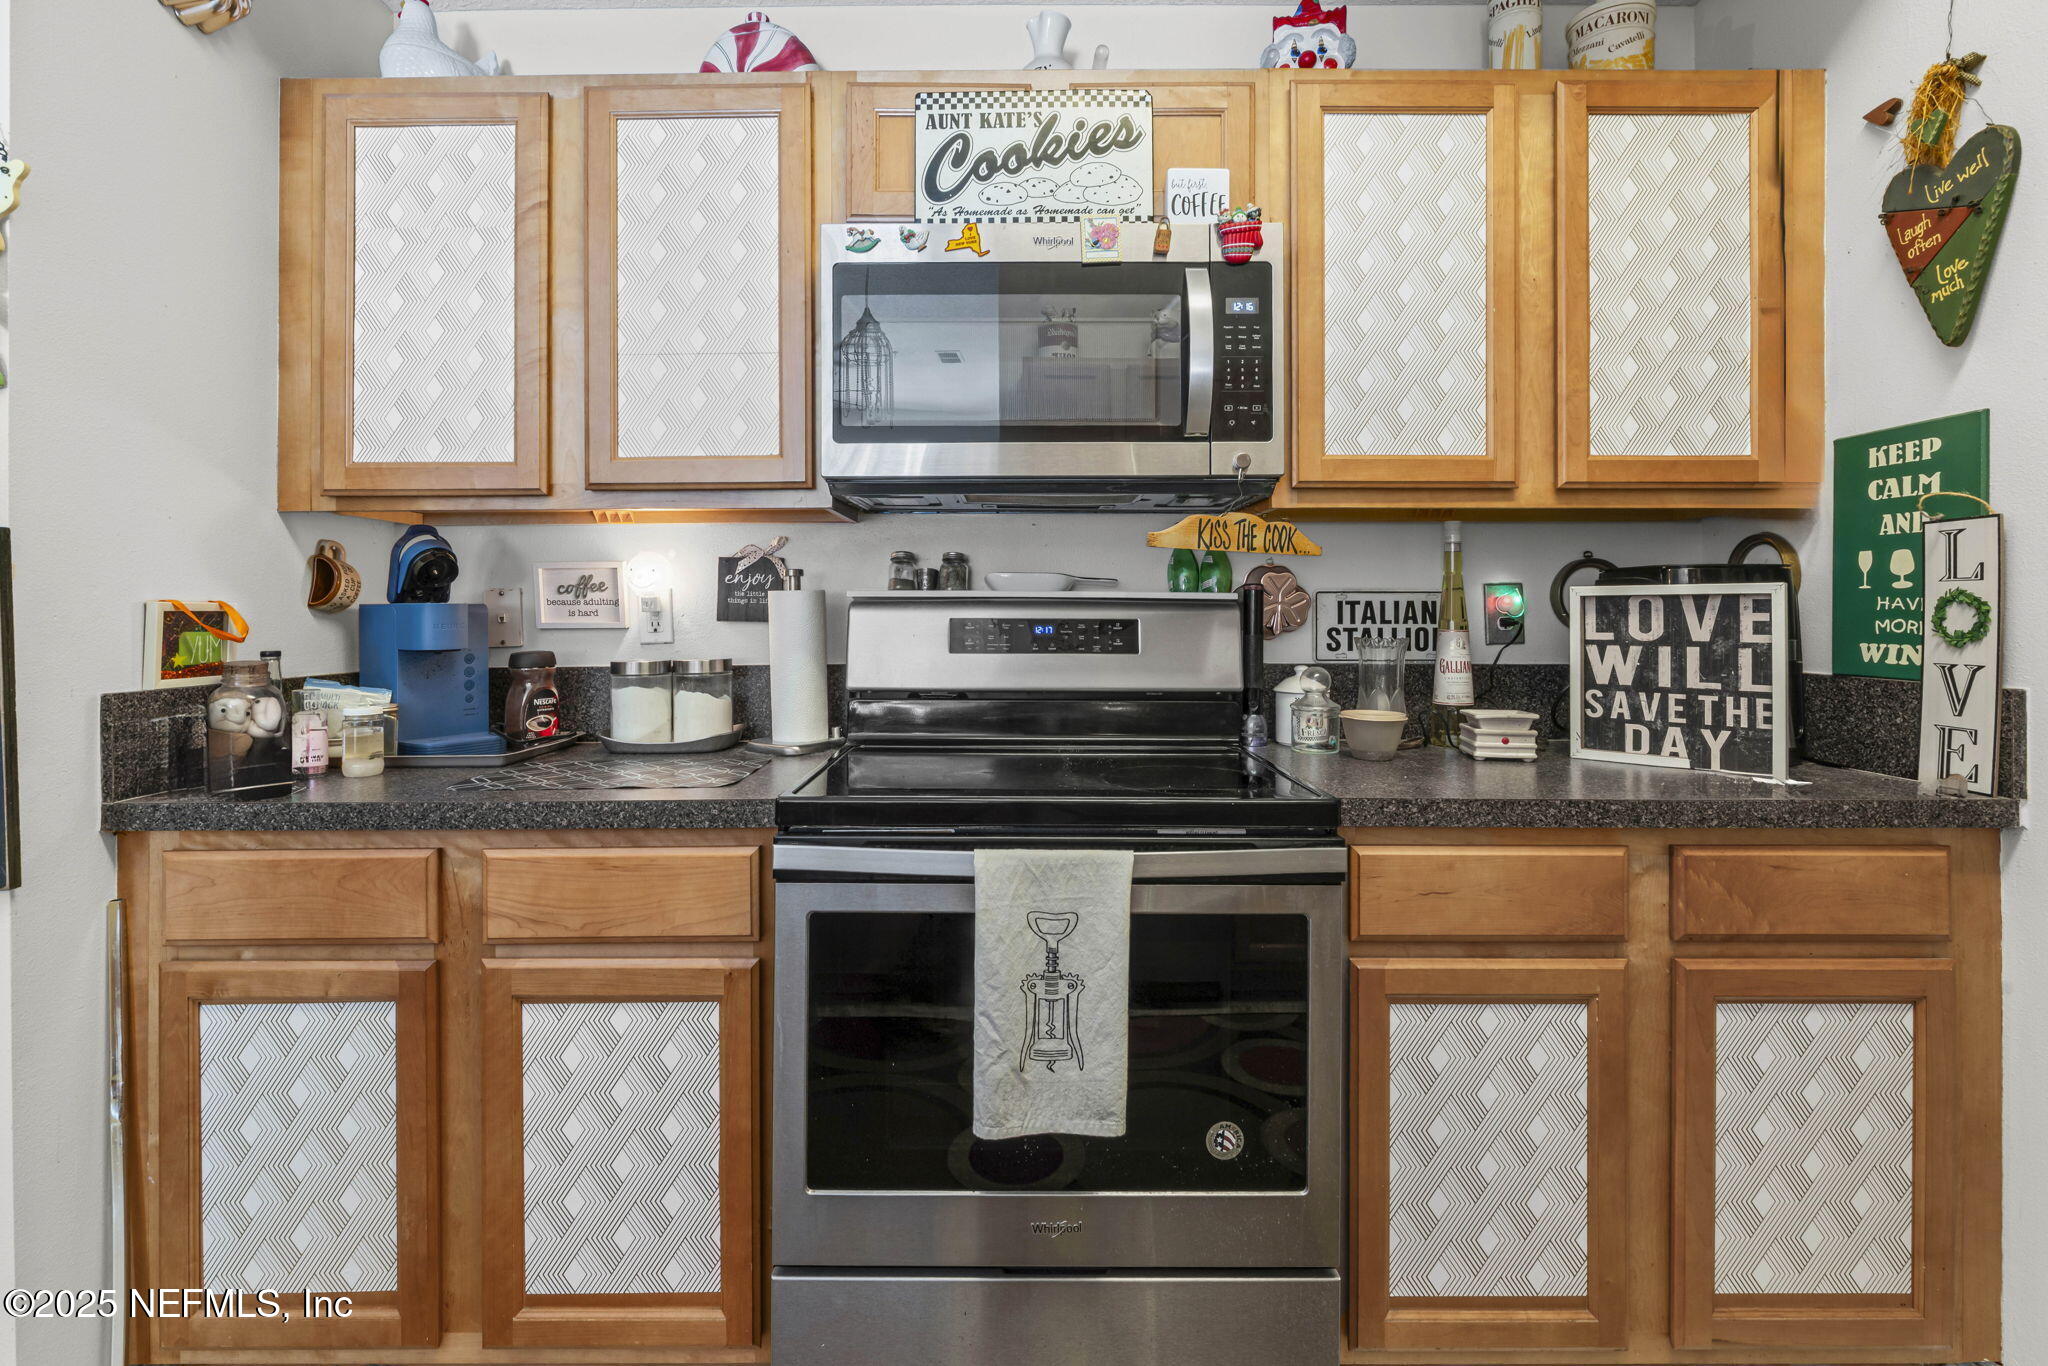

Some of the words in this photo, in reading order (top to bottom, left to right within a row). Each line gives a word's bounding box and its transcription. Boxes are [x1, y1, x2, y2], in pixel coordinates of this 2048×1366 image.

[1576, 11, 1649, 40] MACARONI
[1608, 31, 1646, 53] Cavatelli
[925, 113, 973, 130] AUNT
[979, 112, 1042, 129] KATE'S
[922, 111, 1145, 204] Cookies
[1925, 178, 1954, 204] Live
[1957, 147, 1990, 182] well
[953, 206, 1012, 216] Homemade
[1033, 205, 1093, 215] Homemade
[1171, 192, 1227, 217] COFFEE
[1897, 213, 1931, 245] Laugh
[1033, 236, 1074, 250] Whirlpool
[1907, 231, 1942, 259] often
[1935, 256, 1969, 285] Love
[1930, 273, 1965, 304] much
[1868, 437, 1942, 469] KEEP
[1867, 471, 1942, 501] CALM
[1198, 518, 1231, 550] KISS
[1234, 518, 1258, 551] THE
[557, 574, 608, 599] coffee
[725, 573, 775, 591] enjoy
[546, 598, 581, 606] because
[583, 598, 620, 607] adulting
[568, 609, 576, 617] is
[577, 609, 599, 617] hard
[1337, 601, 1437, 625] ITALIAN
[1877, 596, 1923, 612] HAV
[1035, 626, 1053, 634] 12:17
[1585, 594, 1773, 643] LOVE
[1875, 618, 1923, 635] MOR
[186, 635, 222, 664] YUM
[1326, 627, 1438, 651] STIO
[1440, 658, 1472, 675] GALLIAN
[1859, 642, 1923, 666] WIN
[1586, 644, 1773, 693] WILL
[1585, 689, 1687, 724] SAVE
[1698, 695, 1773, 729] THE
[1625, 723, 1731, 771] DAY
[1031, 1220, 1082, 1238] Whirlpool
